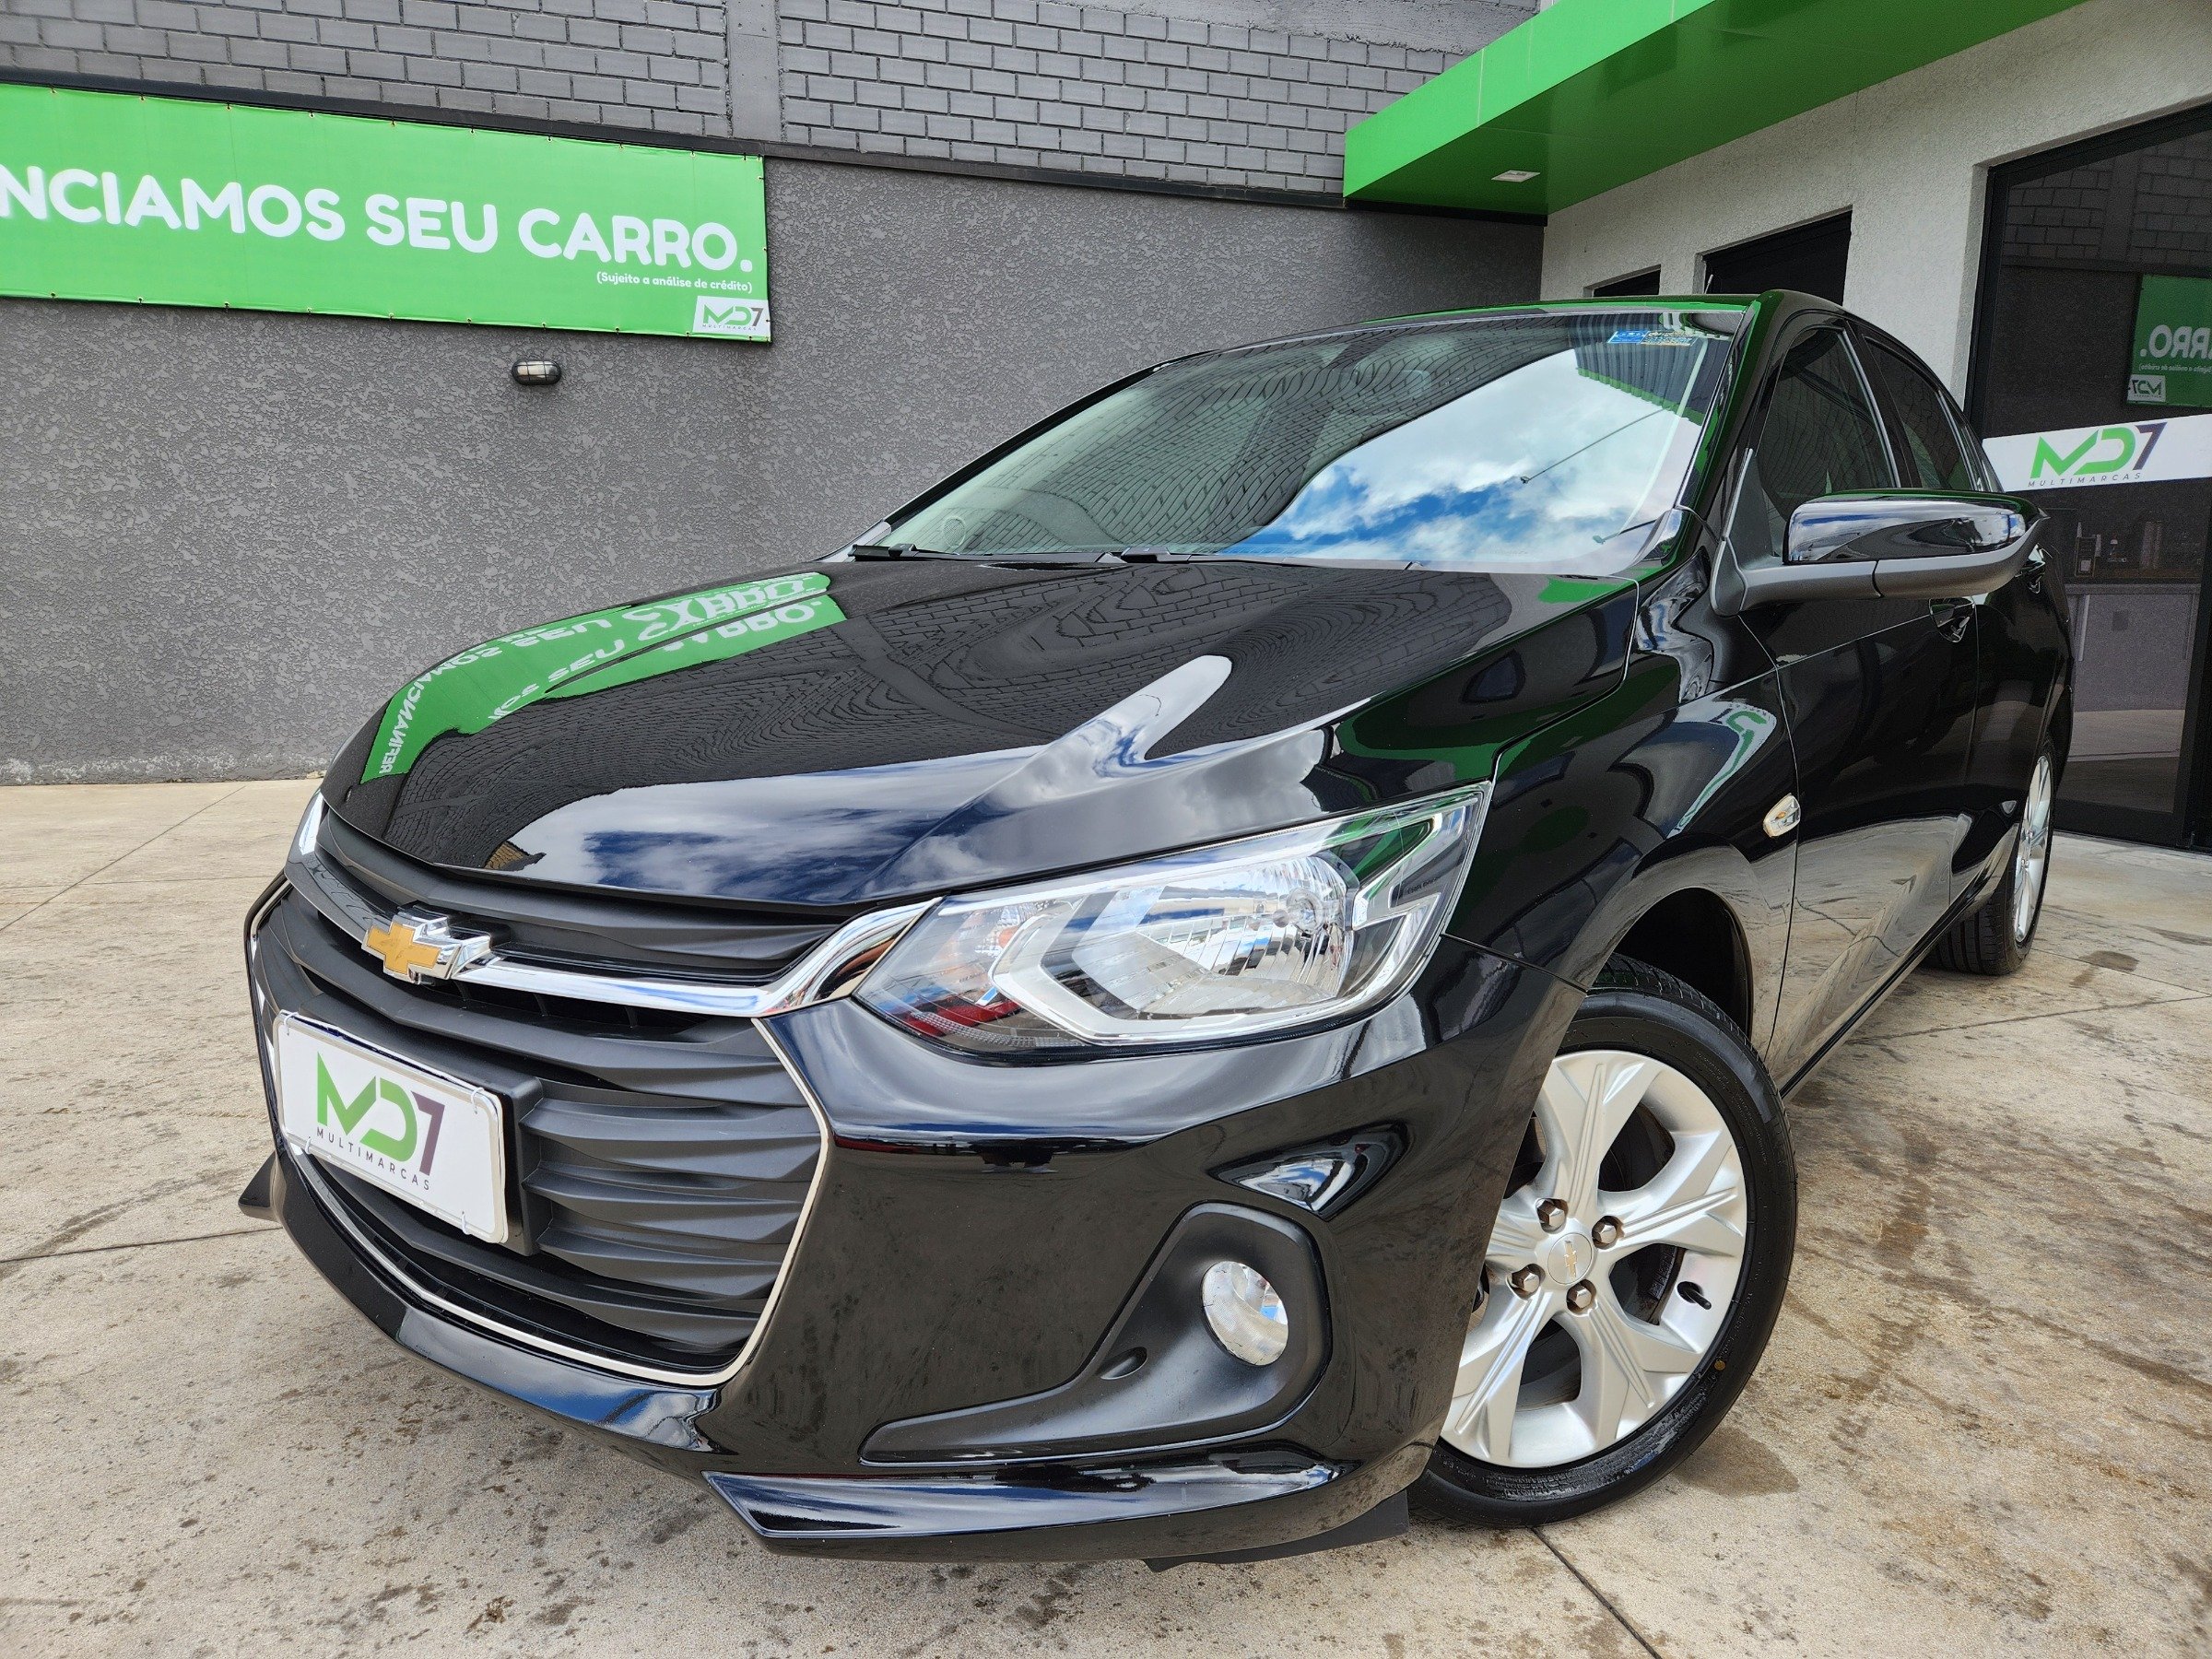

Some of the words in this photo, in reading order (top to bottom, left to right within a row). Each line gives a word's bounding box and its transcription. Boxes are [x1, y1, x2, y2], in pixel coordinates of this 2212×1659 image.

[0, 164, 346, 241] NCIAMOS
[365, 194, 499, 253] SEU
[518, 208, 754, 272] CARRO.
[596, 271, 641, 286] (Sujeito
[642, 276, 651, 285] a
[652, 276, 691, 288] análise
[694, 278, 708, 288] de
[710, 280, 752, 294] crédito)
[702, 304, 764, 327] MD7
[2030, 421, 2168, 479] MD7
[2028, 472, 2141, 488] MULTIMARCAS
[317, 1051, 445, 1176] MD7
[315, 1126, 432, 1191] MULTIMARCAS
